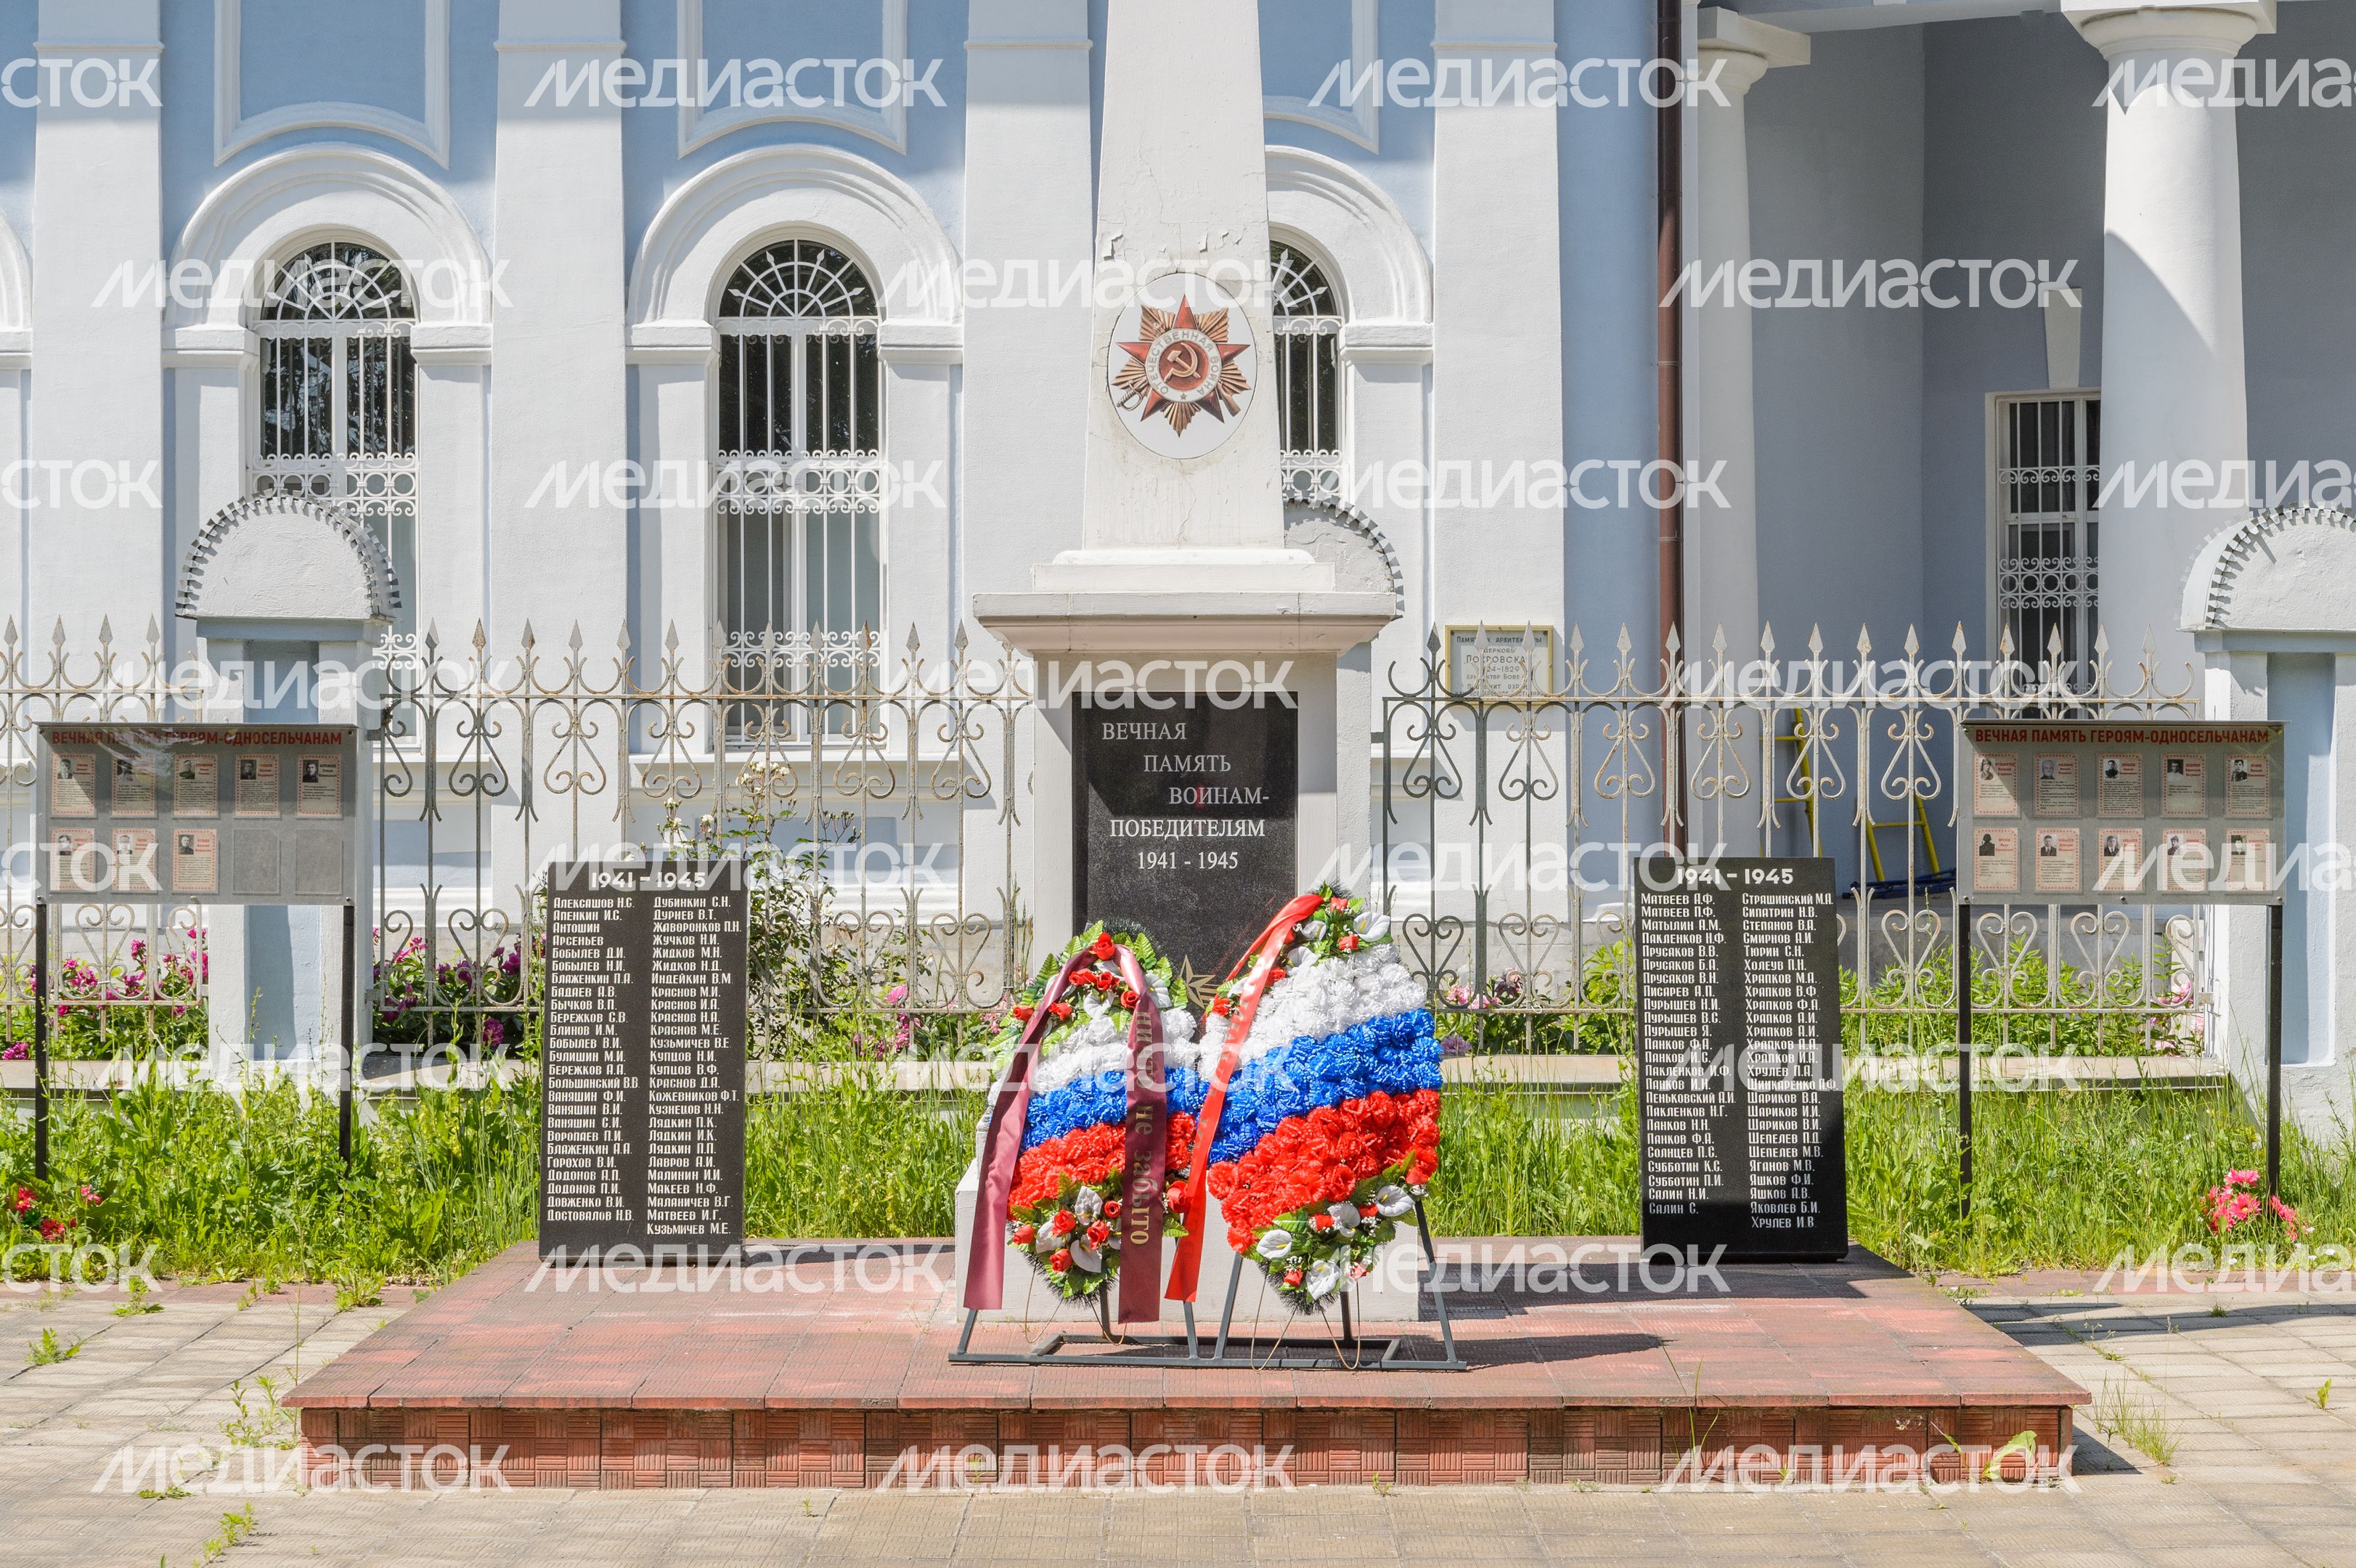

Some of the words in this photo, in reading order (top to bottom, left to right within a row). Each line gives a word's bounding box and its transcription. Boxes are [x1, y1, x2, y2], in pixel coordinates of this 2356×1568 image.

[1149, 331, 1213, 394] ОТЕЧЕСТВЕННАЯ
[1197, 356, 1219, 395] ВОЙНА
[52, 732, 102, 744] ВЕЧНАЯ
[1102, 722, 1186, 740] ВЕЧНАЯ
[1975, 730, 2027, 743] ВЕЧНАЯ
[2032, 730, 2086, 743] ПАМЯТЬ
[2090, 730, 2269, 745] ГЕРОЯМ-ОДНОСЕЛЬЧАНАМ
[1144, 755, 1231, 772] ПАМЯТЬ
[1169, 787, 1269, 804] ВОИНАМ-
[1110, 819, 1265, 841] ПОБЕДИТЕЛЯМ
[1138, 852, 1176, 869] 1941
[1199, 852, 1238, 869] 1945
[592, 872, 633, 888] 1941
[657, 871, 706, 888] 1945
[1678, 868, 1721, 885] 1941
[1745, 868, 1793, 884] 1945
[1135, 1105, 1154, 1136] не
[1130, 1150, 1157, 1245] забыто
